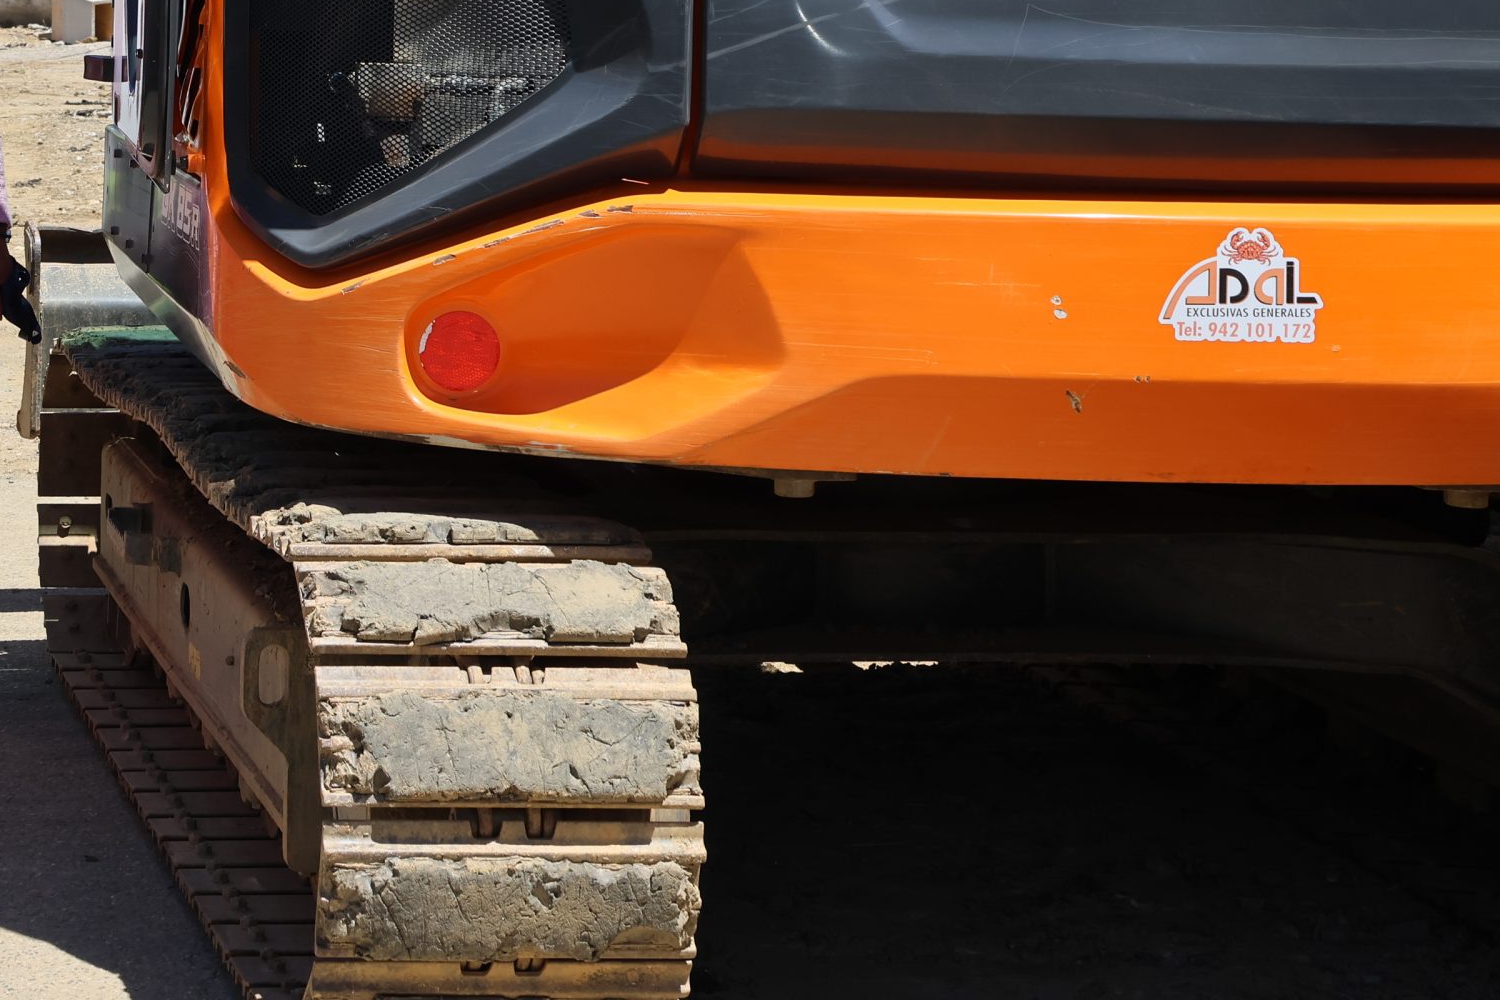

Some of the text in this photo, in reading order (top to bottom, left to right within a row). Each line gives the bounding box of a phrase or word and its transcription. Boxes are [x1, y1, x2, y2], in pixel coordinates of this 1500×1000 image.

[1186, 307, 1312, 318] EXCLUSIVAS GENERALES
[1177, 321, 1311, 338] Tel: 942 101 172
